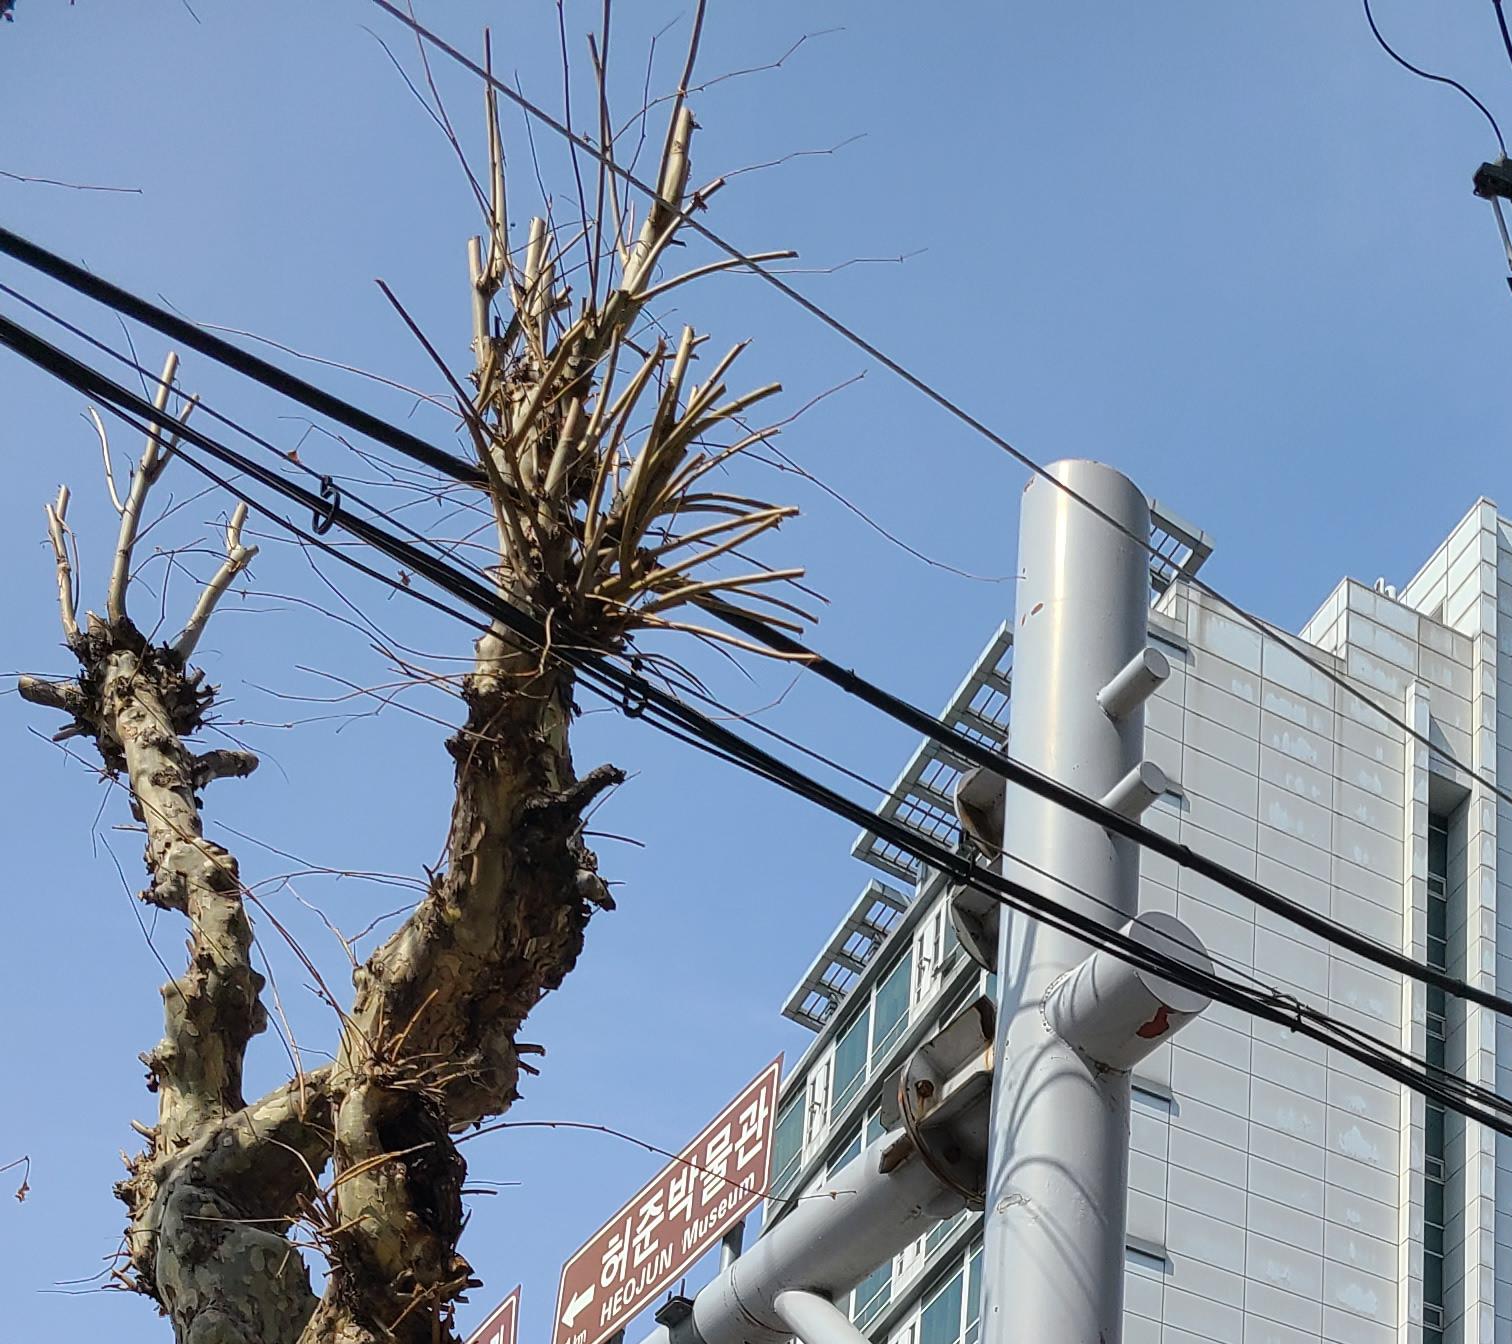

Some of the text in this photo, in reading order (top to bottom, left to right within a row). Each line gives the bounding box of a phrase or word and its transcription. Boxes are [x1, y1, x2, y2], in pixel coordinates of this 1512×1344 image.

[600, 1171, 755, 1326] HEOJUN Museum
[601, 1086, 769, 1288] 허준박물관
